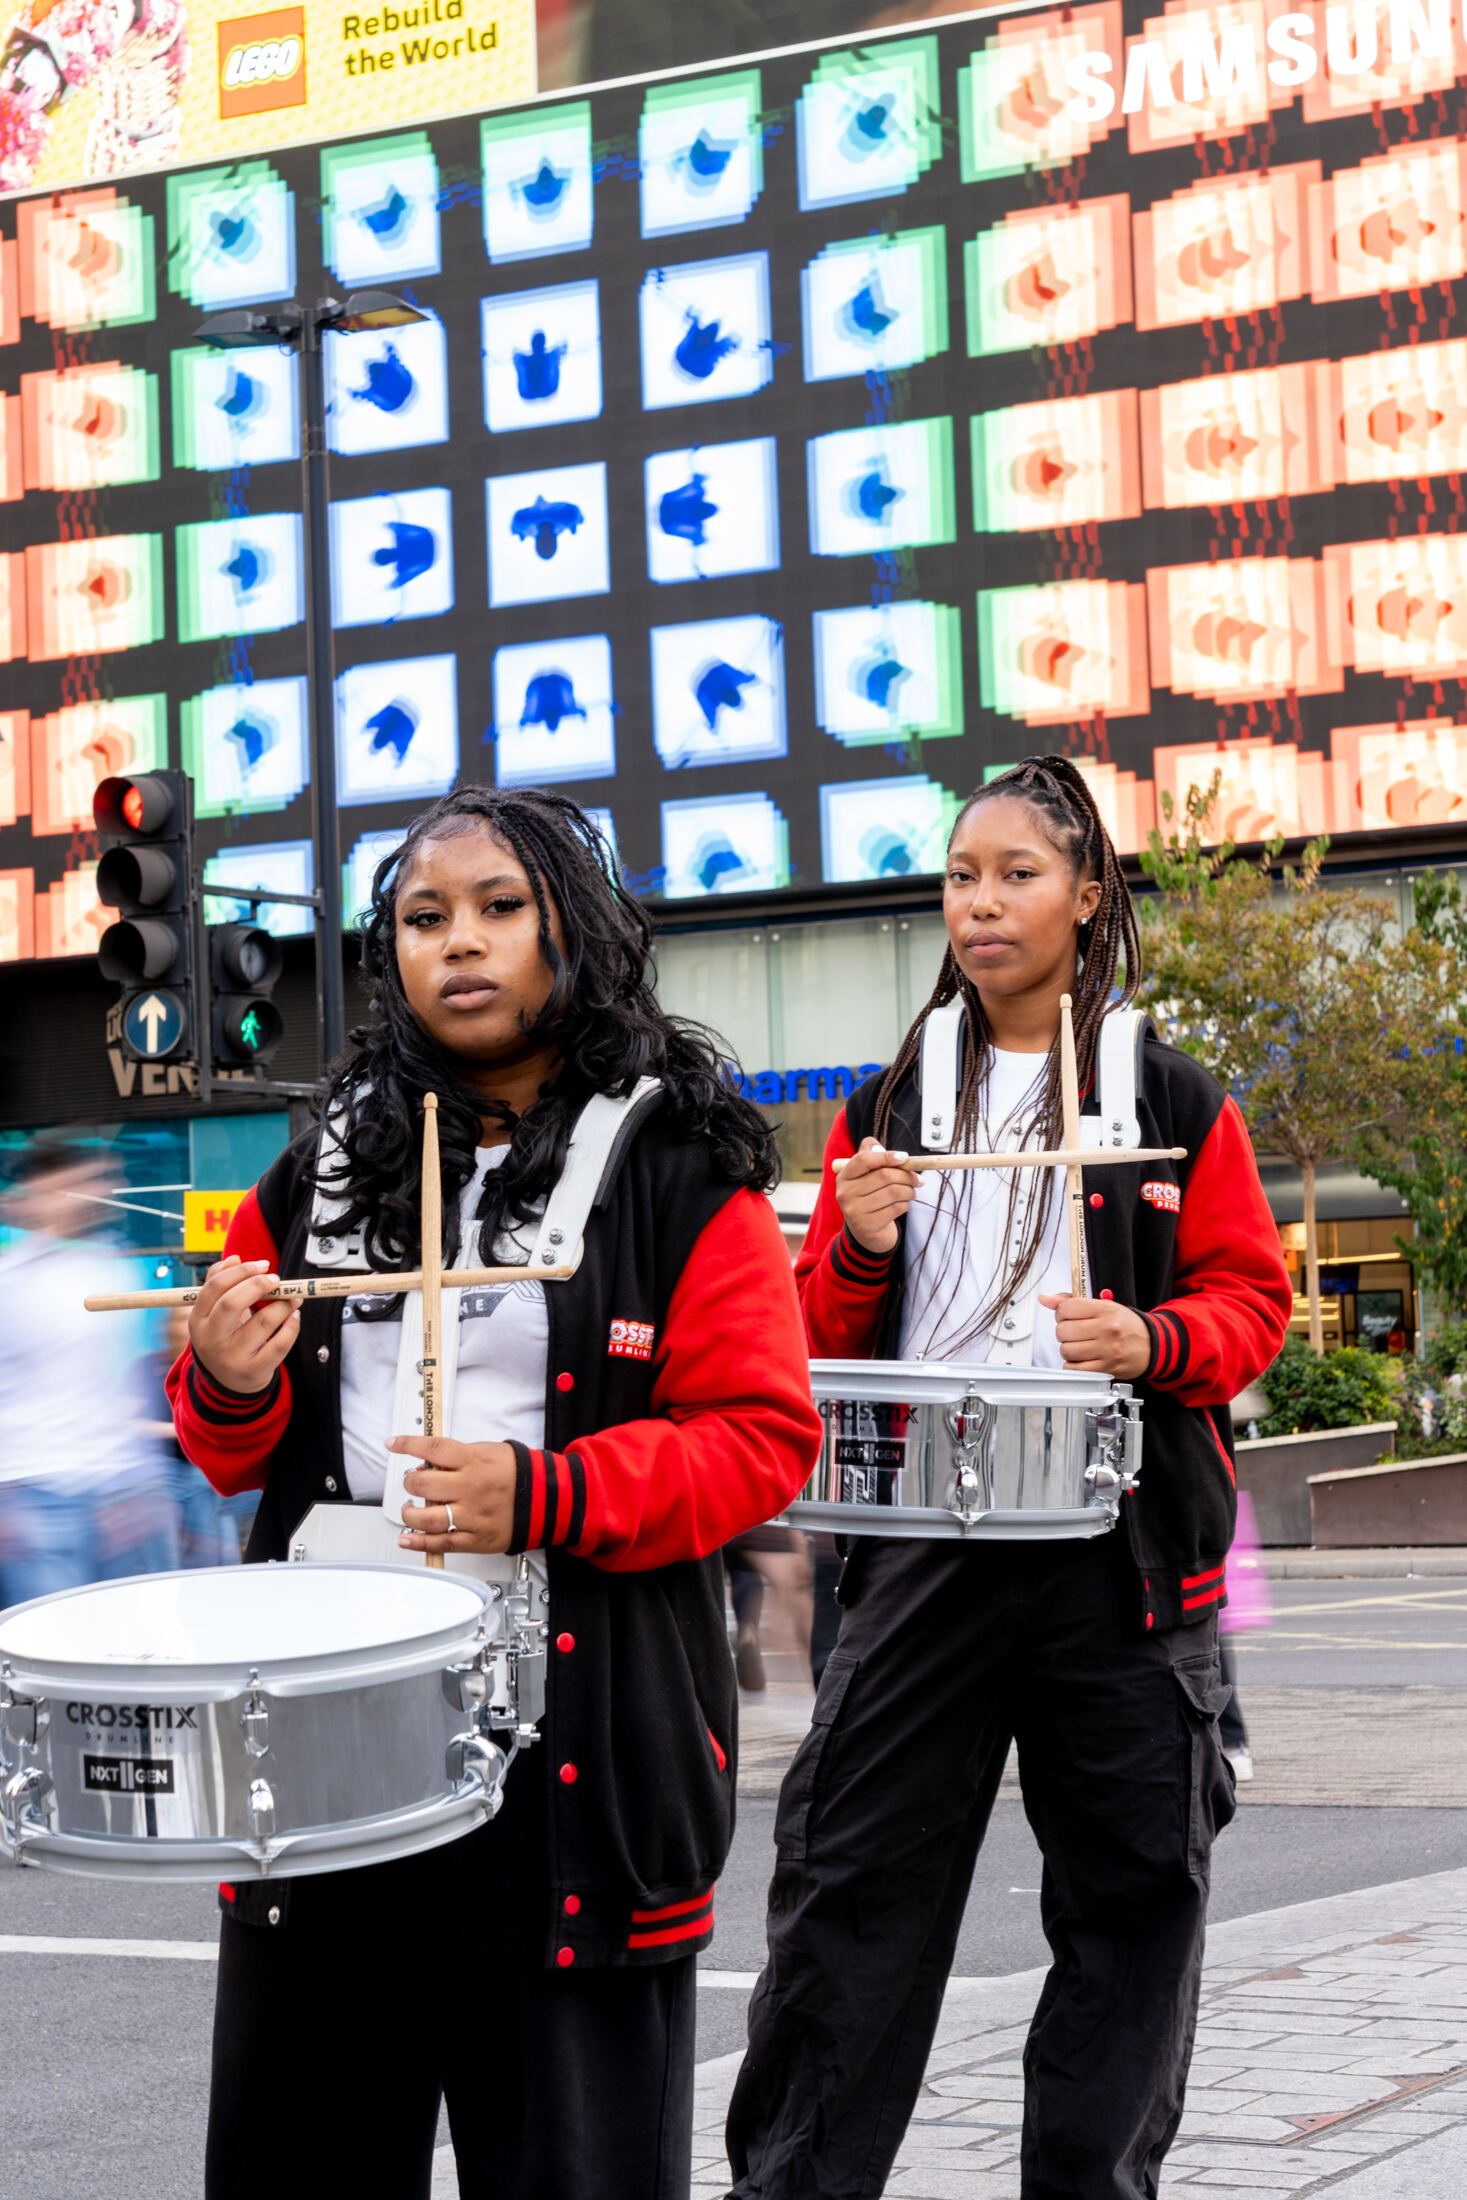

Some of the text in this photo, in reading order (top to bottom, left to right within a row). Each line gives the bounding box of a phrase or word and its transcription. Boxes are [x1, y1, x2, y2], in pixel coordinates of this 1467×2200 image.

[343, 0, 464, 40] Rebuild
[225, 38, 300, 87] LEGO
[345, 22, 499, 76] the World
[1066, 0, 1467, 124] SAMSUN
[426, 1394, 434, 1437] LONDON
[818, 1402, 919, 1425] CROSSTIX
[66, 1701, 198, 1729] CROSSTIX
[86, 1731, 175, 1745] DRUMLINE
[89, 1765, 168, 1785] NXT GEN
